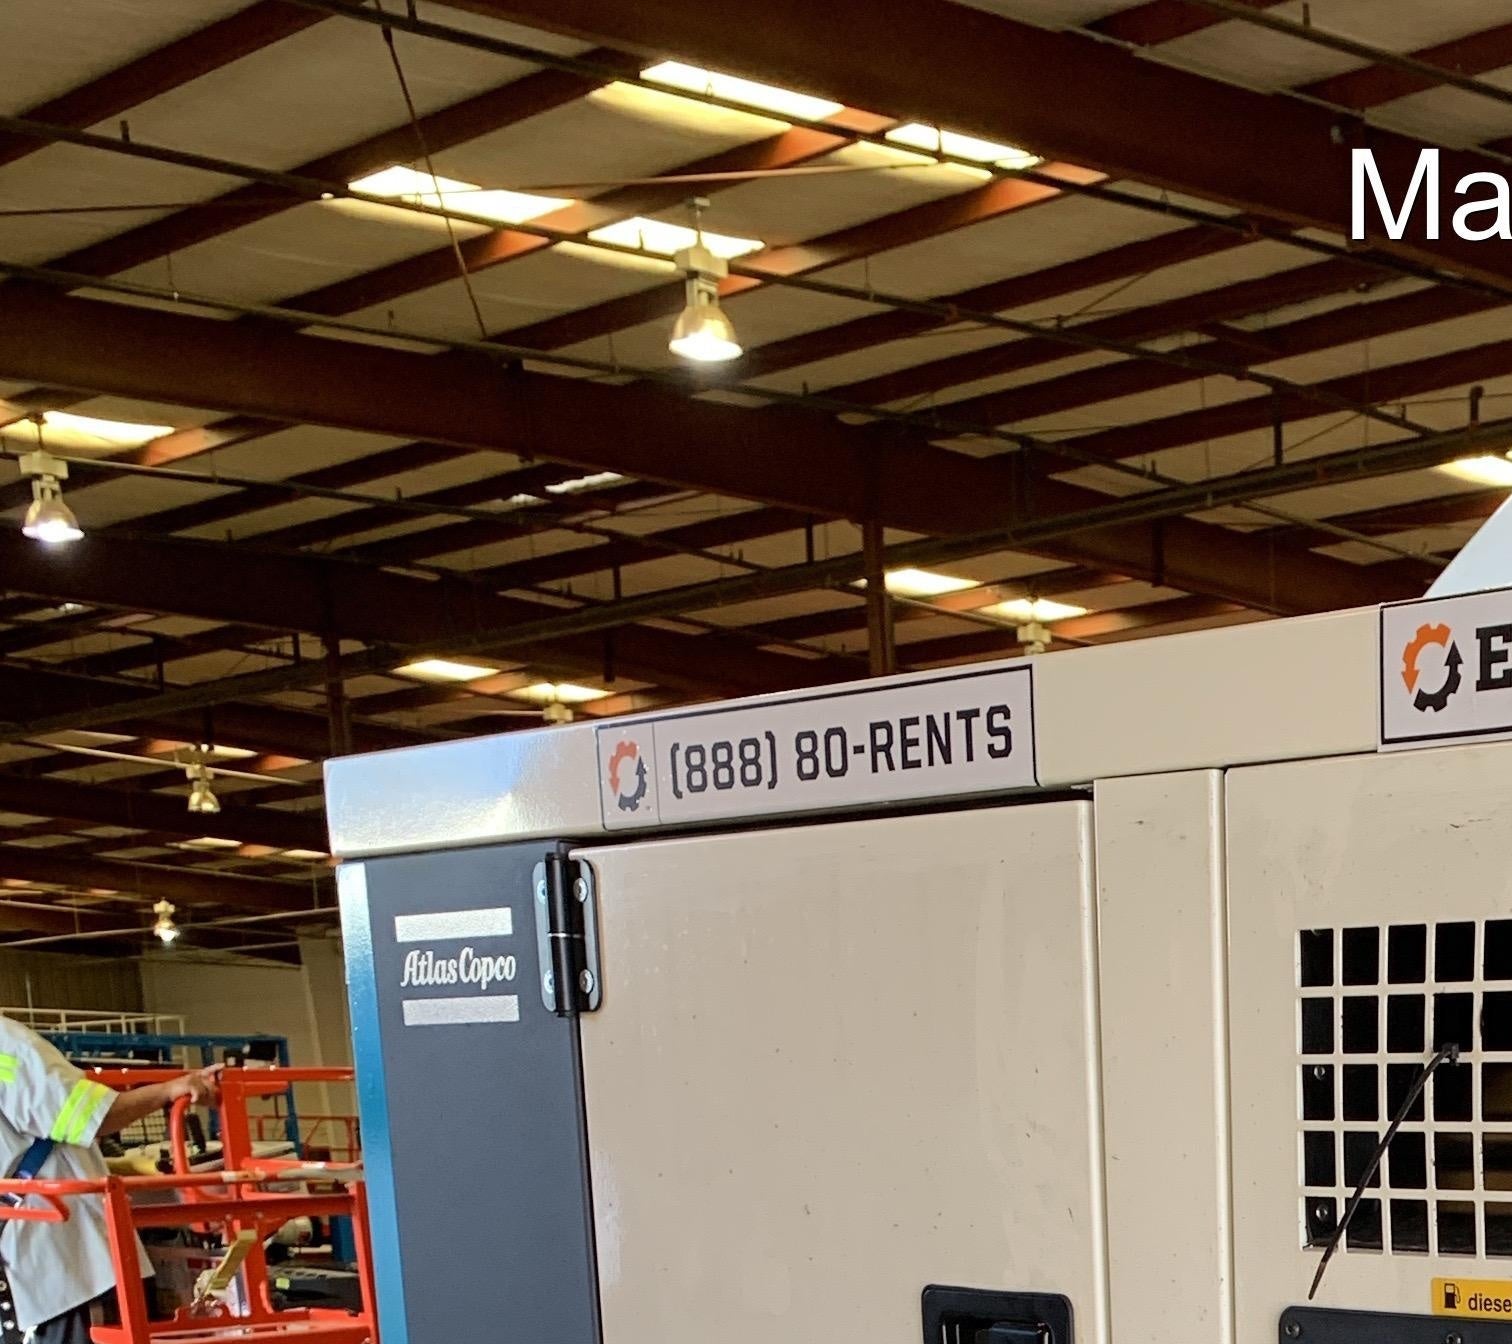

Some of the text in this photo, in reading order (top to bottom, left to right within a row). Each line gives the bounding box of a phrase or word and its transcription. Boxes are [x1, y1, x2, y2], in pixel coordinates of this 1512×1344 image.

[670, 704, 1013, 800] (888) 80-RENTS
[400, 947, 517, 990] Atlas Copco
